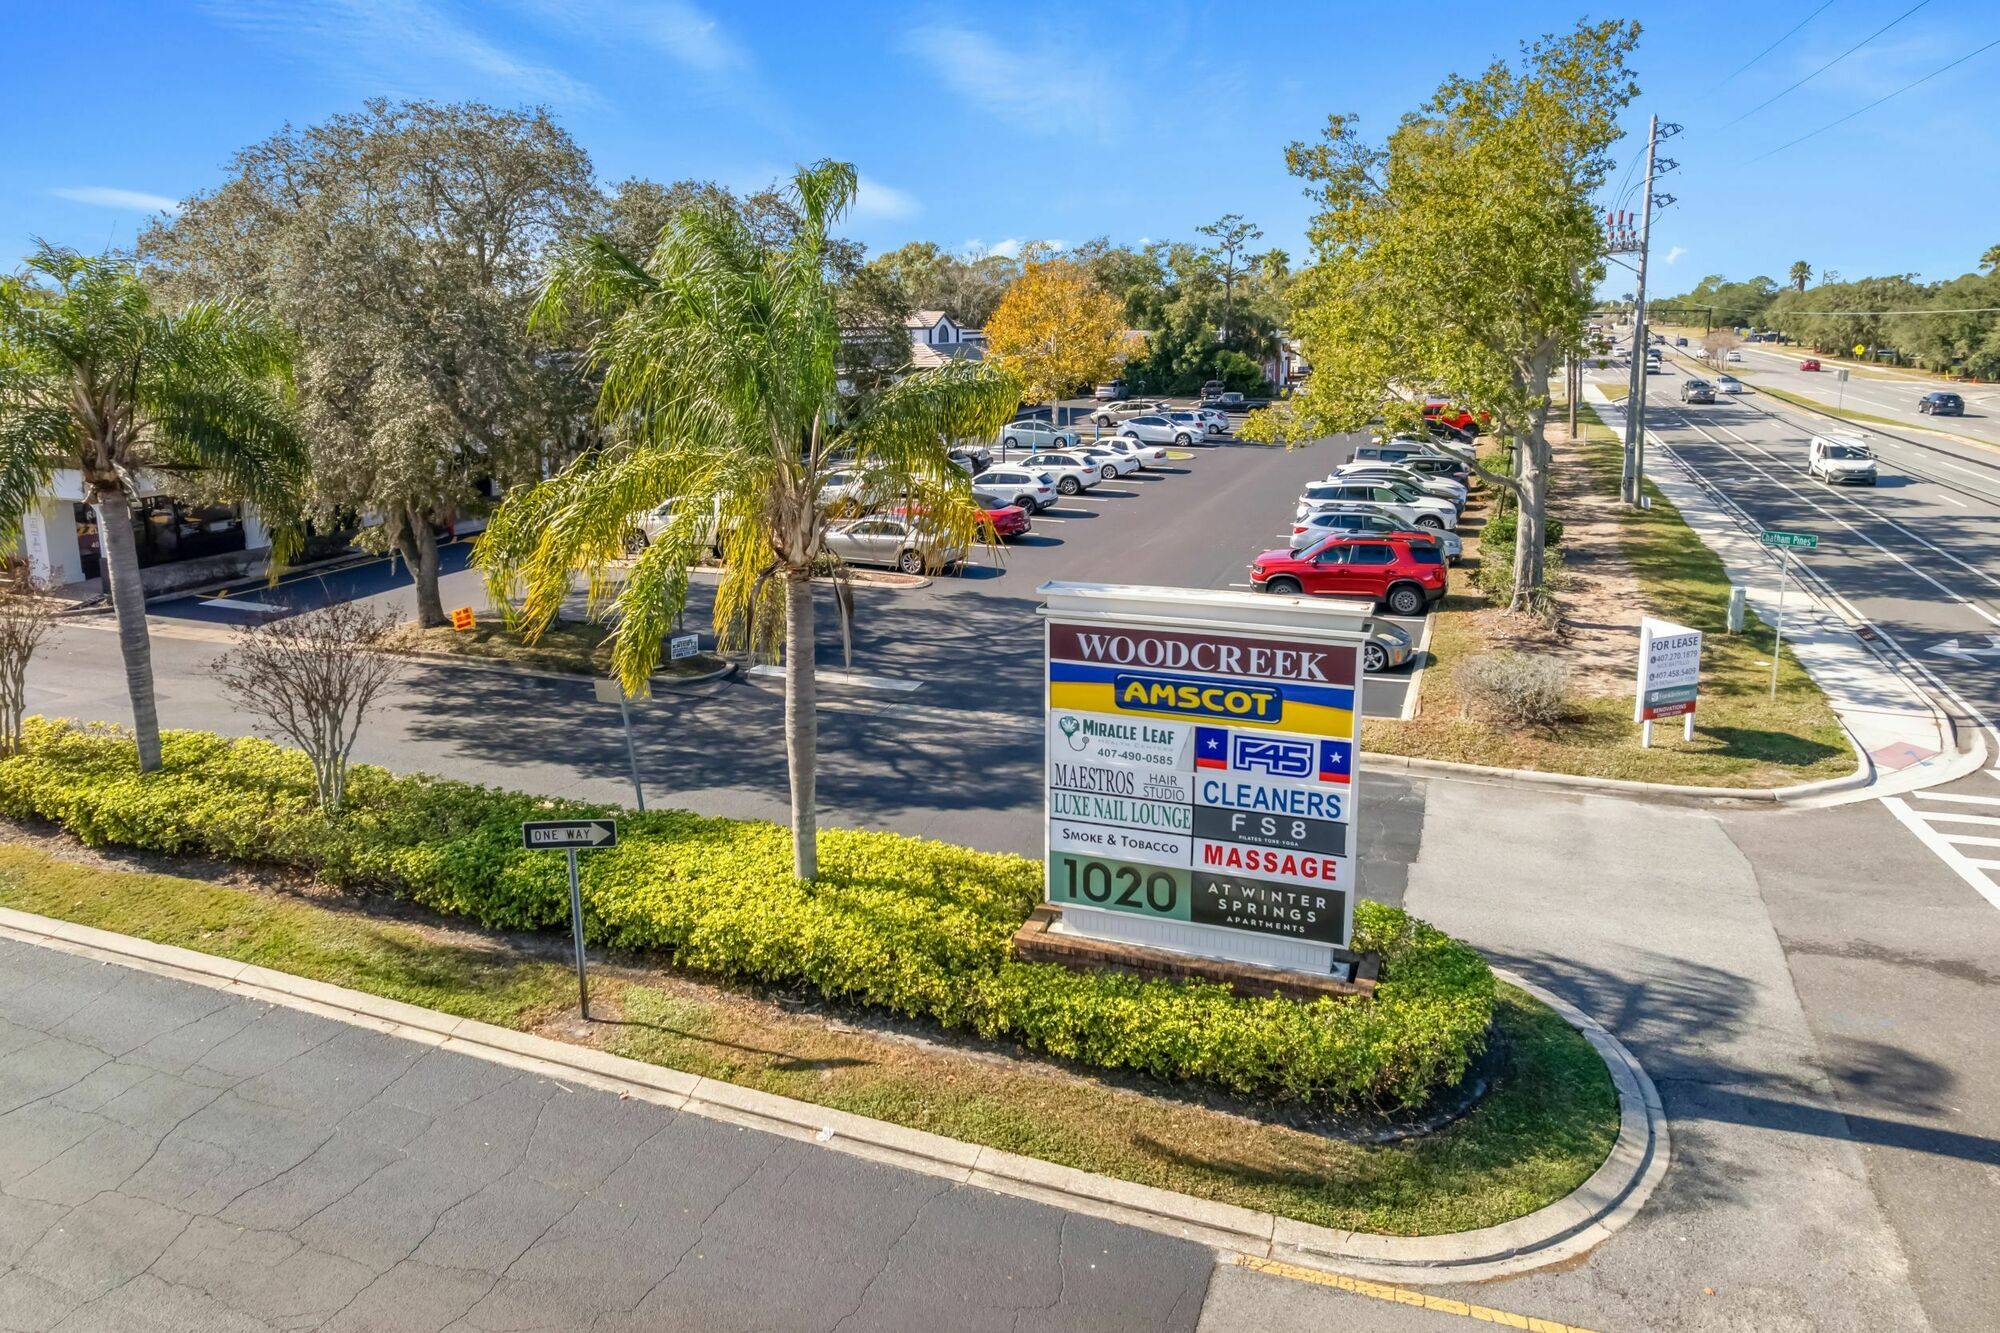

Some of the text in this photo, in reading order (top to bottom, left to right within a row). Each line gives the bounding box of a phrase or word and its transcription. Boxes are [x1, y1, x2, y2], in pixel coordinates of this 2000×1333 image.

[1762, 532, 1790, 544] Chatham
[1792, 536, 1811, 546] Pines
[1076, 632, 1328, 682] WOODCREEK
[1651, 637, 1699, 651] FOR LEASE
[1124, 681, 1273, 716] AMSCOT
[1083, 719, 1175, 745] MIRACLE LEAF
[1098, 747, 1173, 766] 407-490-0585
[1233, 735, 1314, 778] F45
[1055, 763, 1135, 795] MAESTROS
[1150, 773, 1178, 787] HAIR
[1143, 785, 1185, 802] STUDIO
[1203, 780, 1341, 819] CLEANERS
[1055, 793, 1191, 830] LUXE NAIL LOUNGE
[534, 828, 590, 841] ONE WAY
[1063, 828, 1179, 854] SMOKE & TOBACCO
[1204, 844, 1336, 881] MASSAGE
[1064, 858, 1177, 912] 1020
[1208, 882, 1327, 909] AT WINTER
[1218, 898, 1317, 923] SPRINGS
[1226, 915, 1305, 933] APARTMENTS
